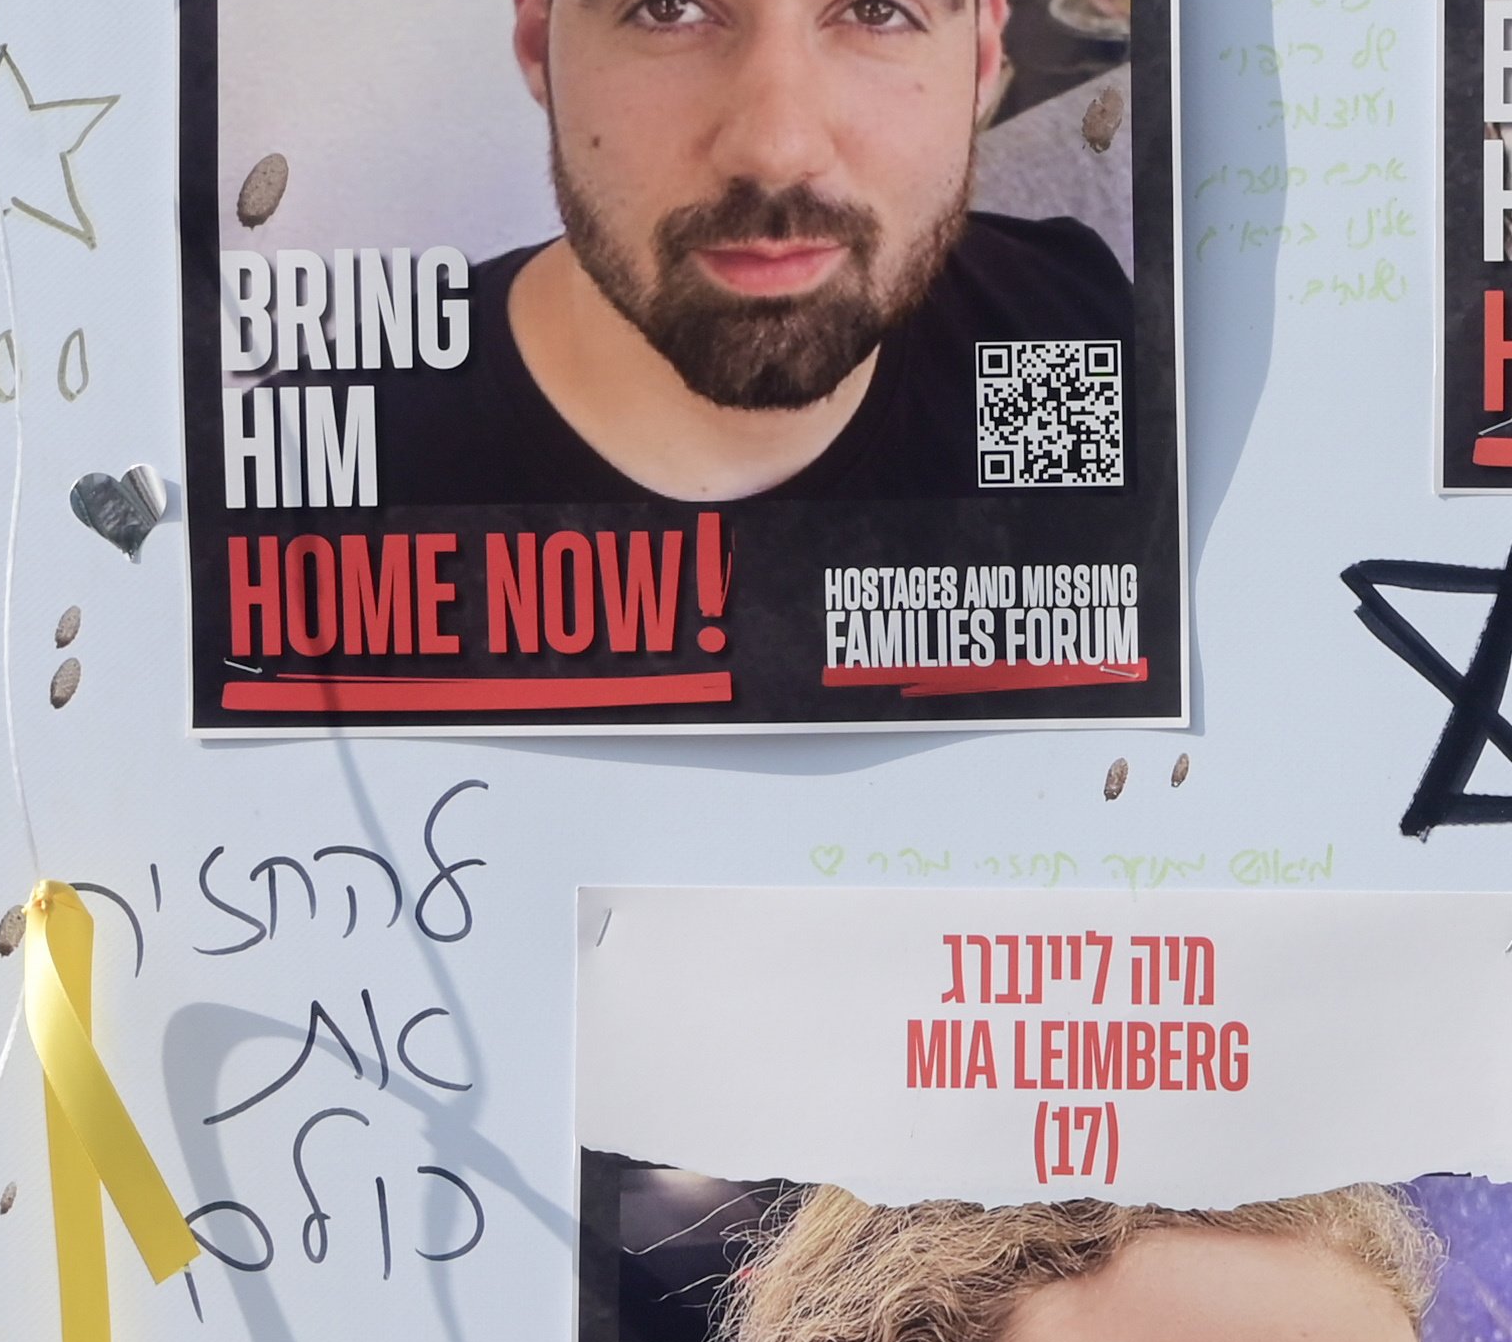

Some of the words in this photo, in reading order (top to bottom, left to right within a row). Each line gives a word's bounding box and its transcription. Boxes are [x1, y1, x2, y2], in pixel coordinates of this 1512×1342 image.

[222, 246, 470, 371] BRING
[222, 372, 377, 508] HIM
[228, 533, 461, 657] HOME
[485, 511, 733, 654] NOW!
[942, 931, 1113, 1005] ליינברג
[1131, 936, 1215, 1005] מיה
[203, 989, 475, 1124] את
[908, 1020, 997, 1089] MIA
[1015, 1020, 1249, 1091] LEIMBERG
[1035, 1101, 1119, 1184] (17)
